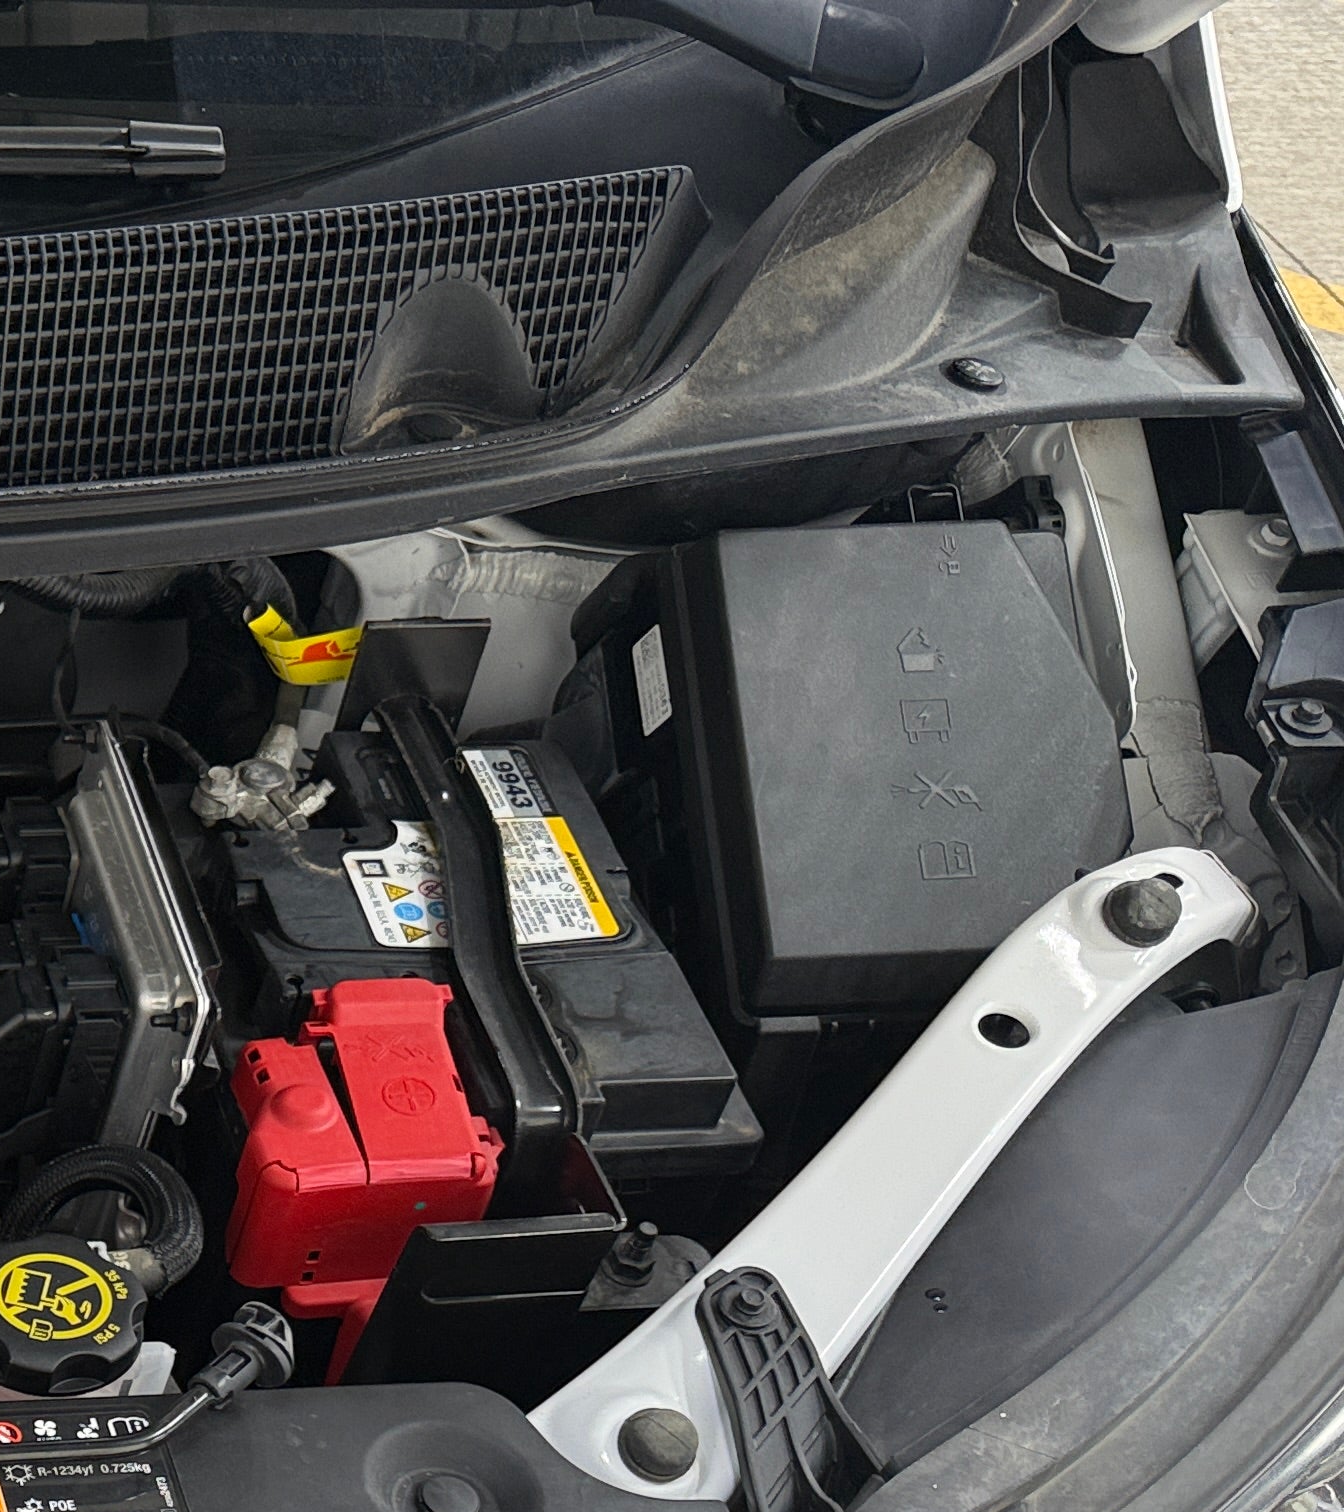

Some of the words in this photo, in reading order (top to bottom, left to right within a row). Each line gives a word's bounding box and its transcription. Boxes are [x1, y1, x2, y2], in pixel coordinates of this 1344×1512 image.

[492, 761, 533, 809] 9943
[104, 1269, 117, 1283] 35
[113, 1282, 129, 1300] kPa
[108, 1323, 121, 1333] 5
[93, 1329, 114, 1345] PSI
[36, 1465, 95, 1477] R-1234yf
[100, 1462, 152, 1475] 0.725kg
[48, 1499, 78, 1512] POE
